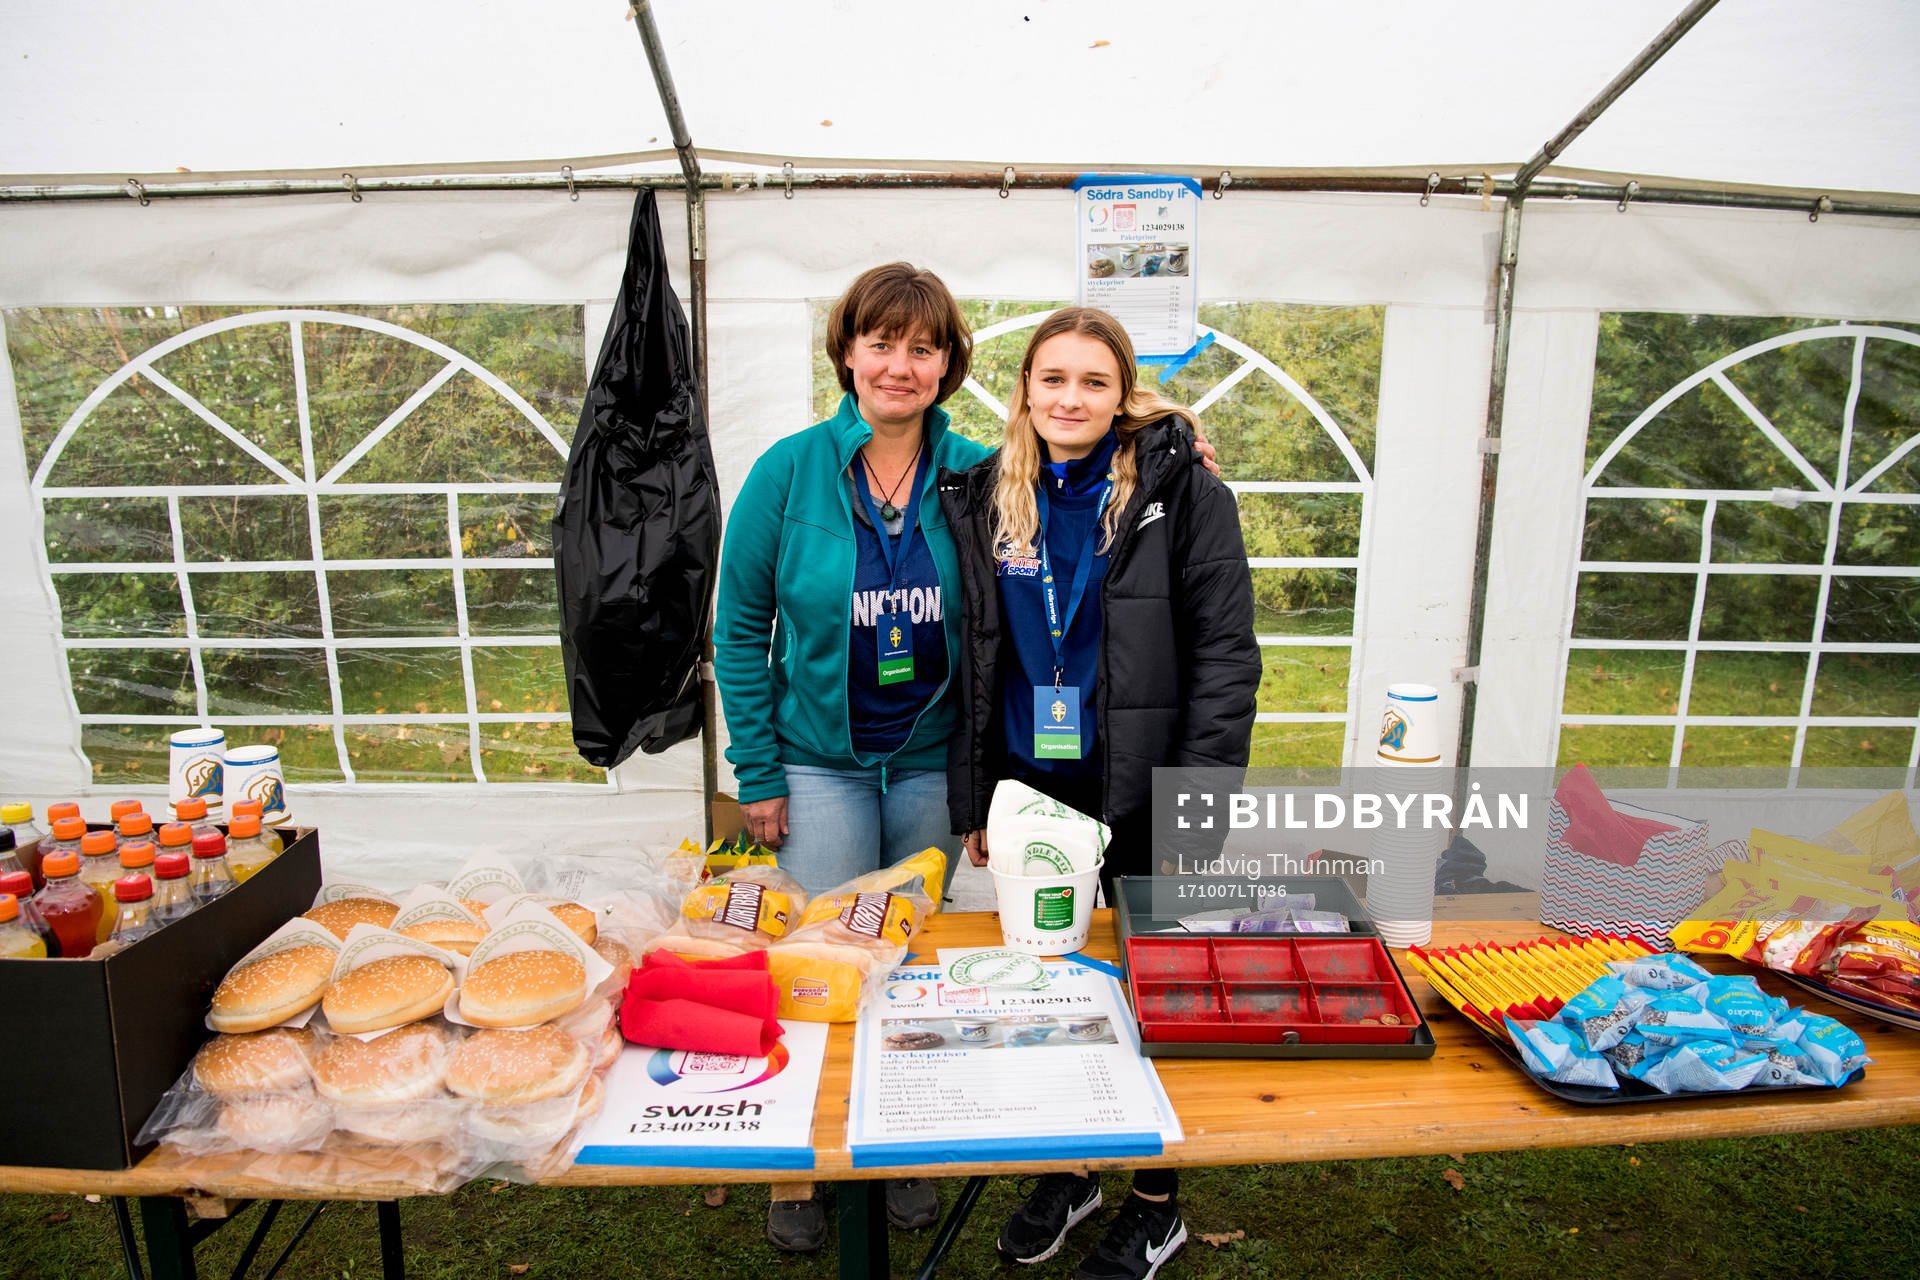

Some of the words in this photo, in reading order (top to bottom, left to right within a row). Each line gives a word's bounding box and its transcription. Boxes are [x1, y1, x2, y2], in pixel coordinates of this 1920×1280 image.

[1087, 189, 1123, 200] Södra
[1128, 188, 1174, 201] Sandby
[1177, 188, 1189, 199] IF
[1010, 559, 1039, 569] INTER
[1008, 567, 1037, 576] SPORT
[851, 586, 944, 627] NKTION
[882, 667, 911, 677] Organisation
[1040, 743, 1078, 751] Organisation
[887, 971, 942, 982] Södr
[1068, 967, 1091, 976] IF
[1001, 996, 1092, 1005] 1234029138
[642, 1100, 763, 1118] swish
[629, 1121, 761, 1134] 1234029138
